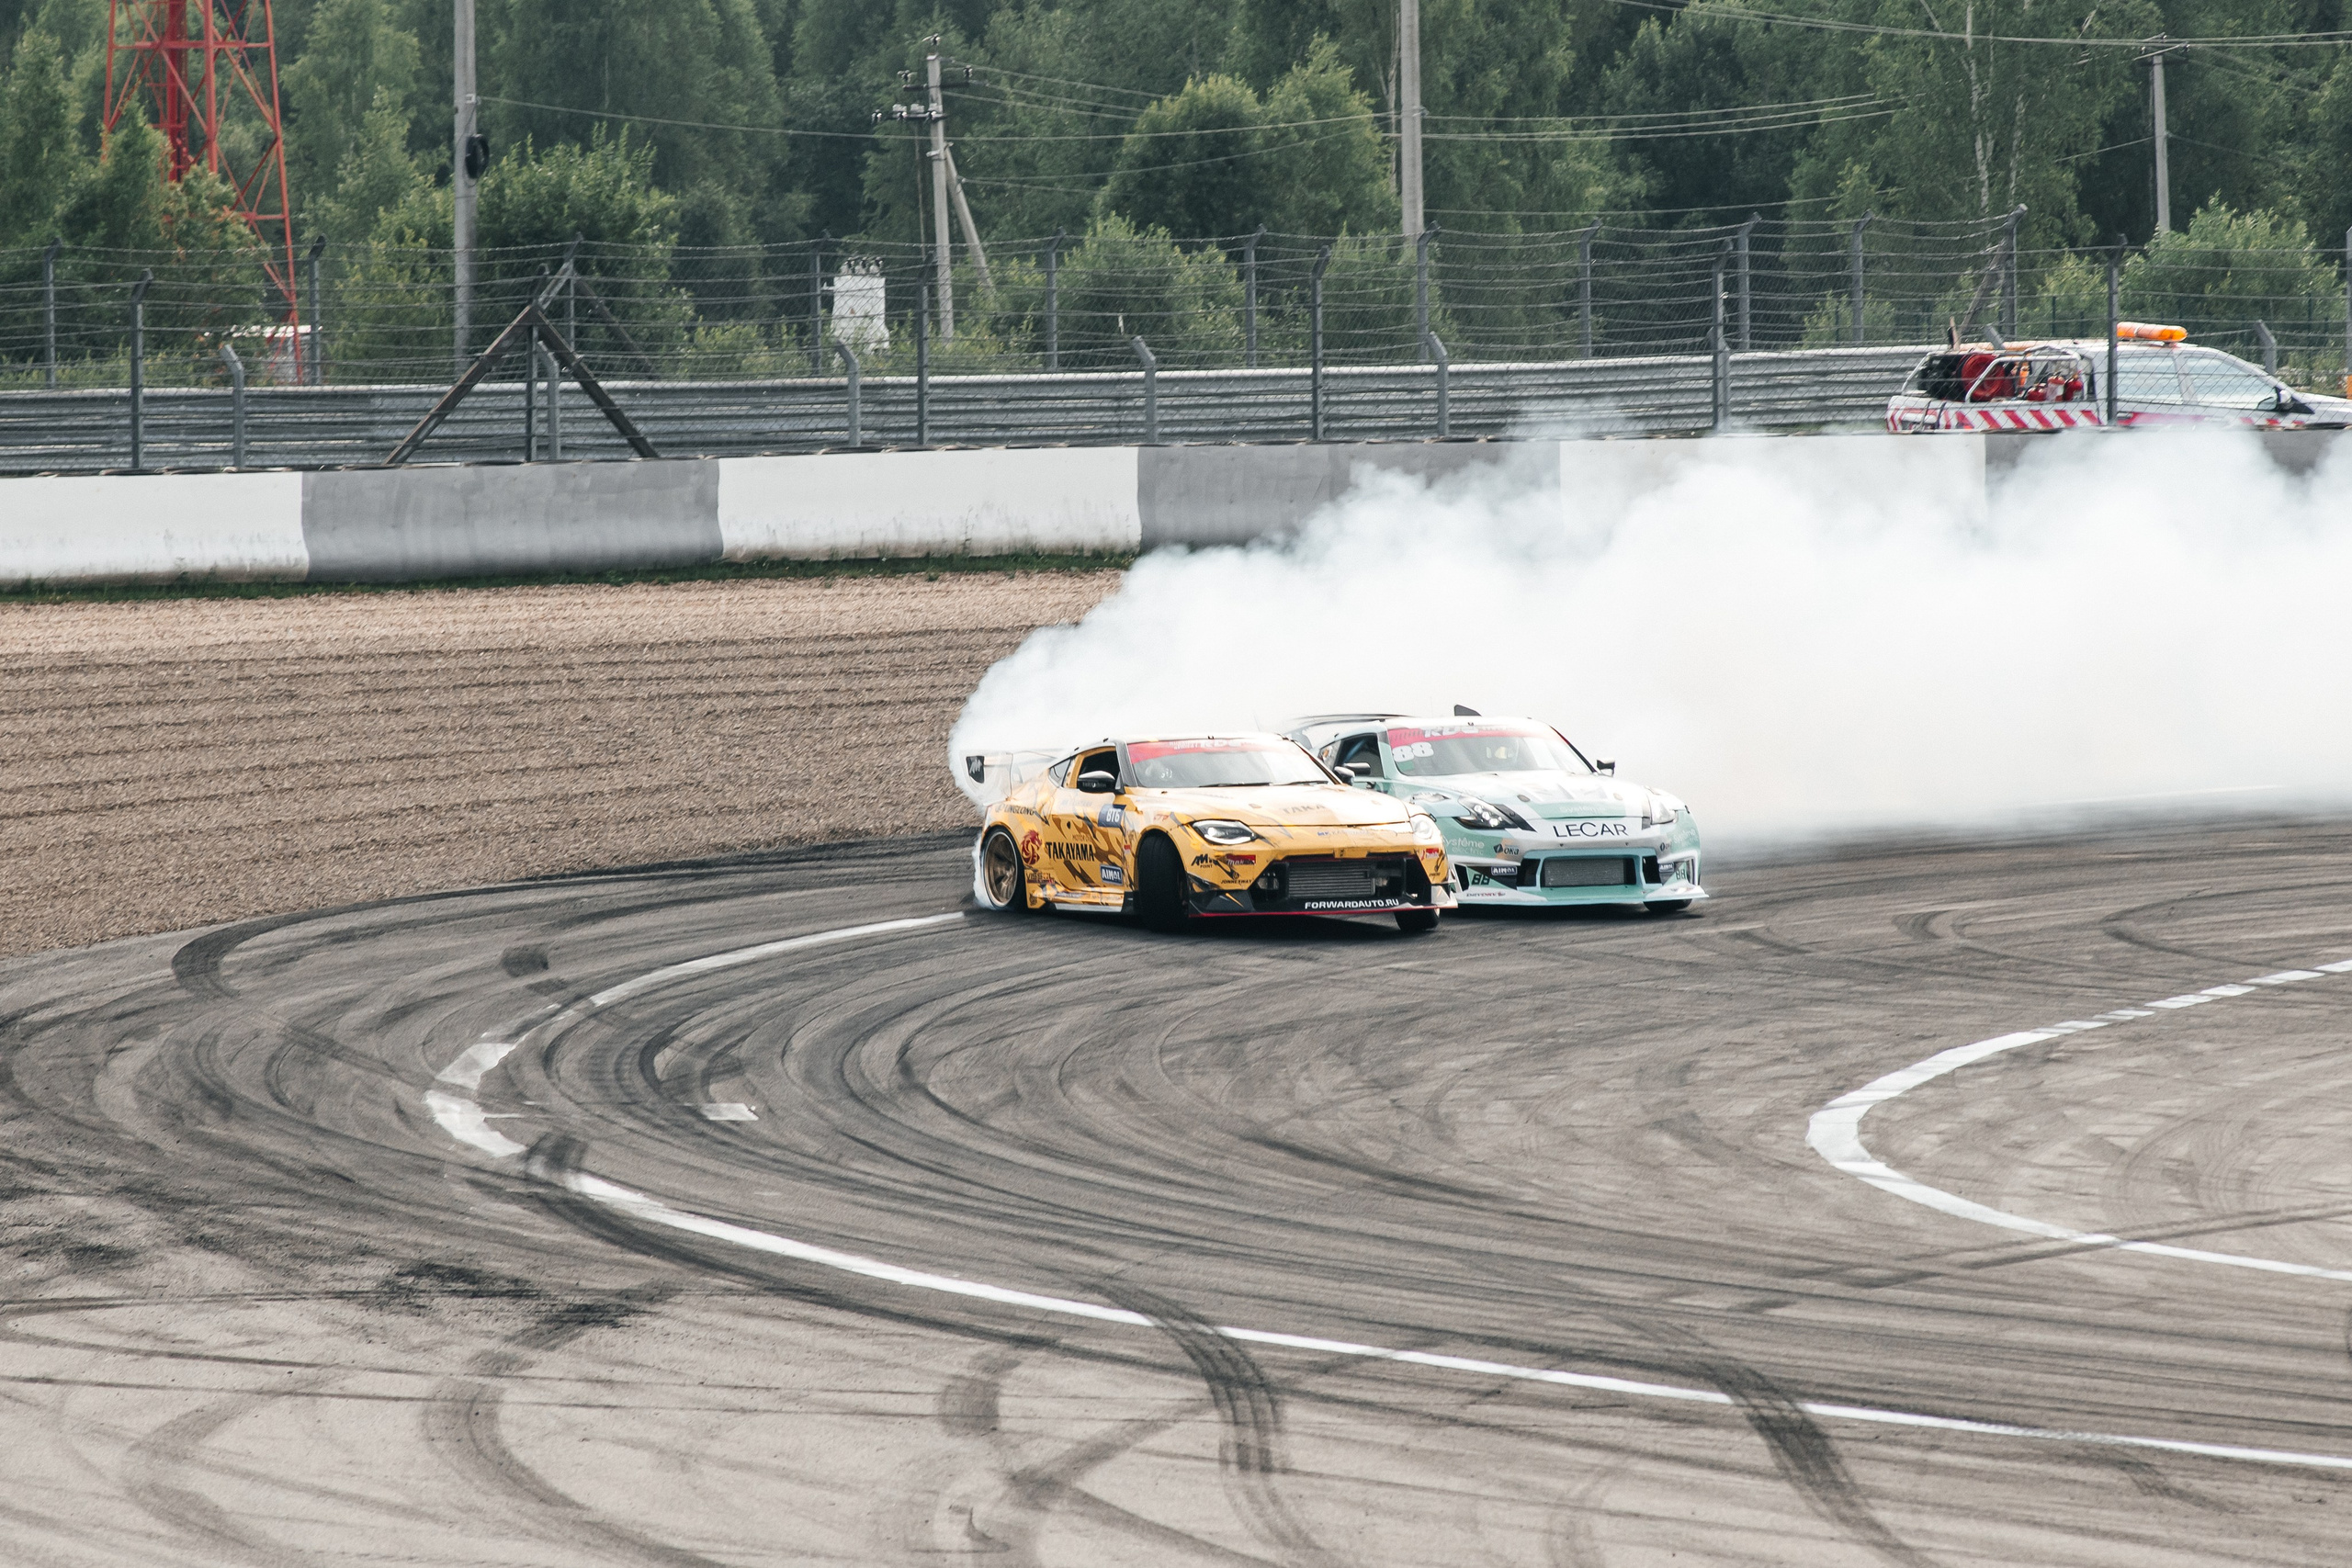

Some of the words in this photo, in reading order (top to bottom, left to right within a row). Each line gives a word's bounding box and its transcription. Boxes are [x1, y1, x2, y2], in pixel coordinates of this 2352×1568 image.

[1392, 741, 1434, 762] 88
[1552, 822, 1629, 838] LECAR
[1046, 842, 1094, 862] TAKAYAMA
[1305, 898, 1399, 909] FORWARDAUTO.RU
